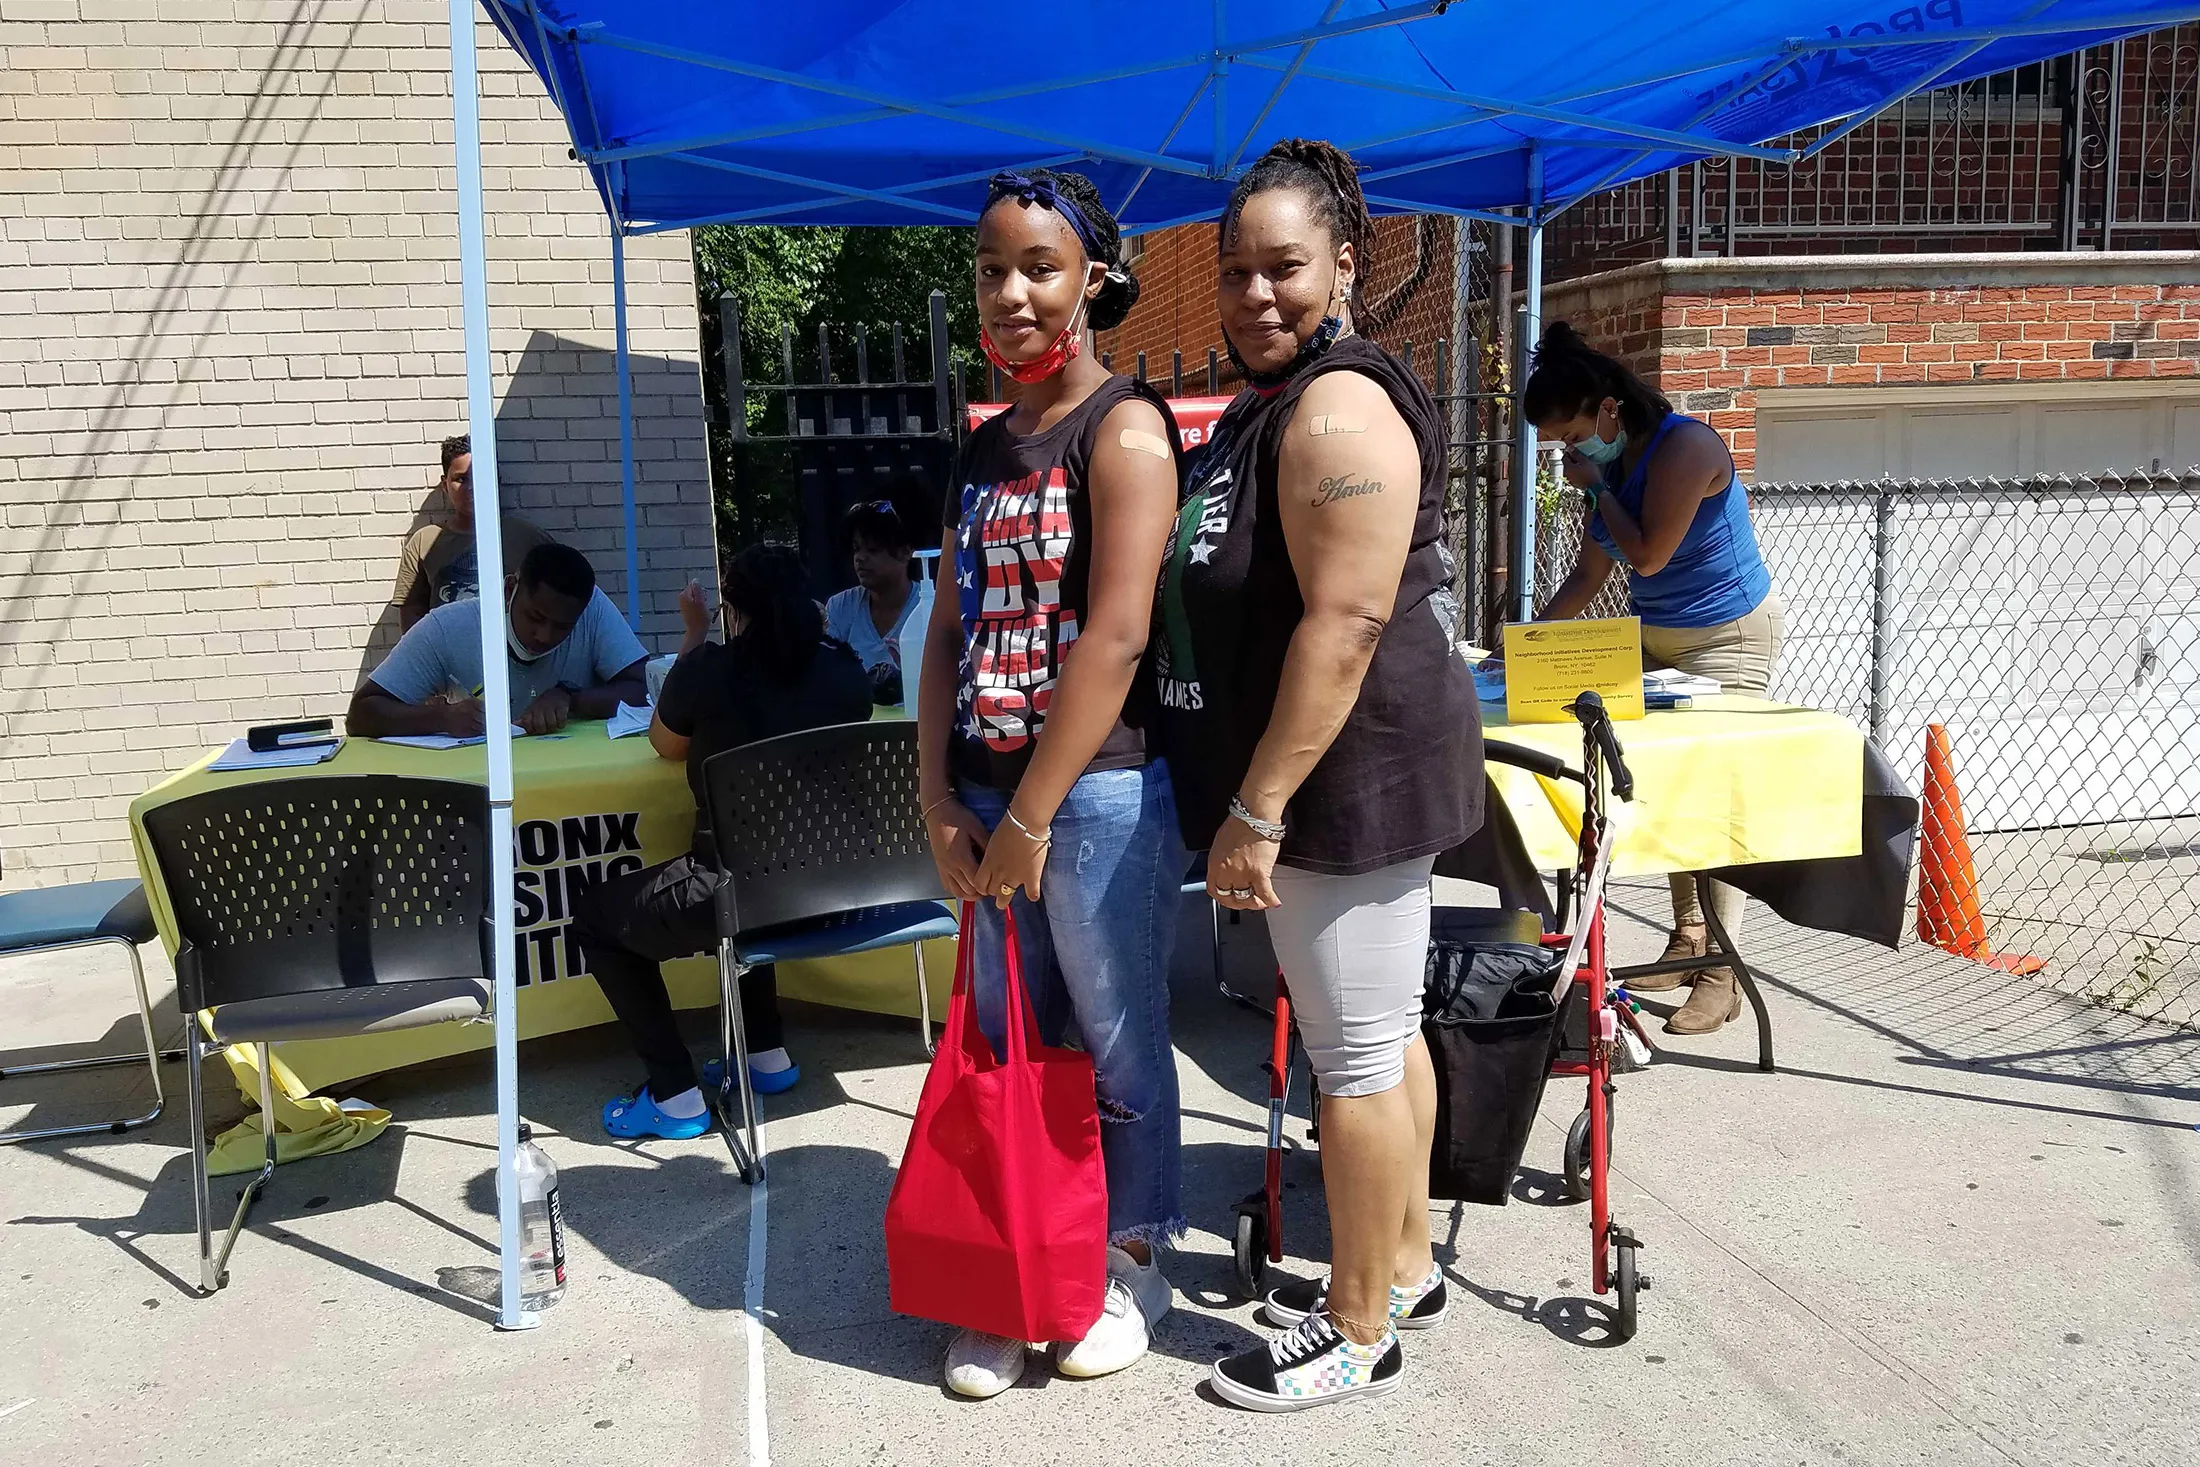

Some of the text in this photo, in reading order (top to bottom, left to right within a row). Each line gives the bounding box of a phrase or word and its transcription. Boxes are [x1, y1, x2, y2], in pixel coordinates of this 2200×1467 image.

[983, 467, 1072, 548] LIKE A
[1311, 473, 1386, 507] Amin
[976, 613, 1049, 689] LIKE
[1582, 646, 1618, 654] Development
[514, 812, 642, 867] ONX
